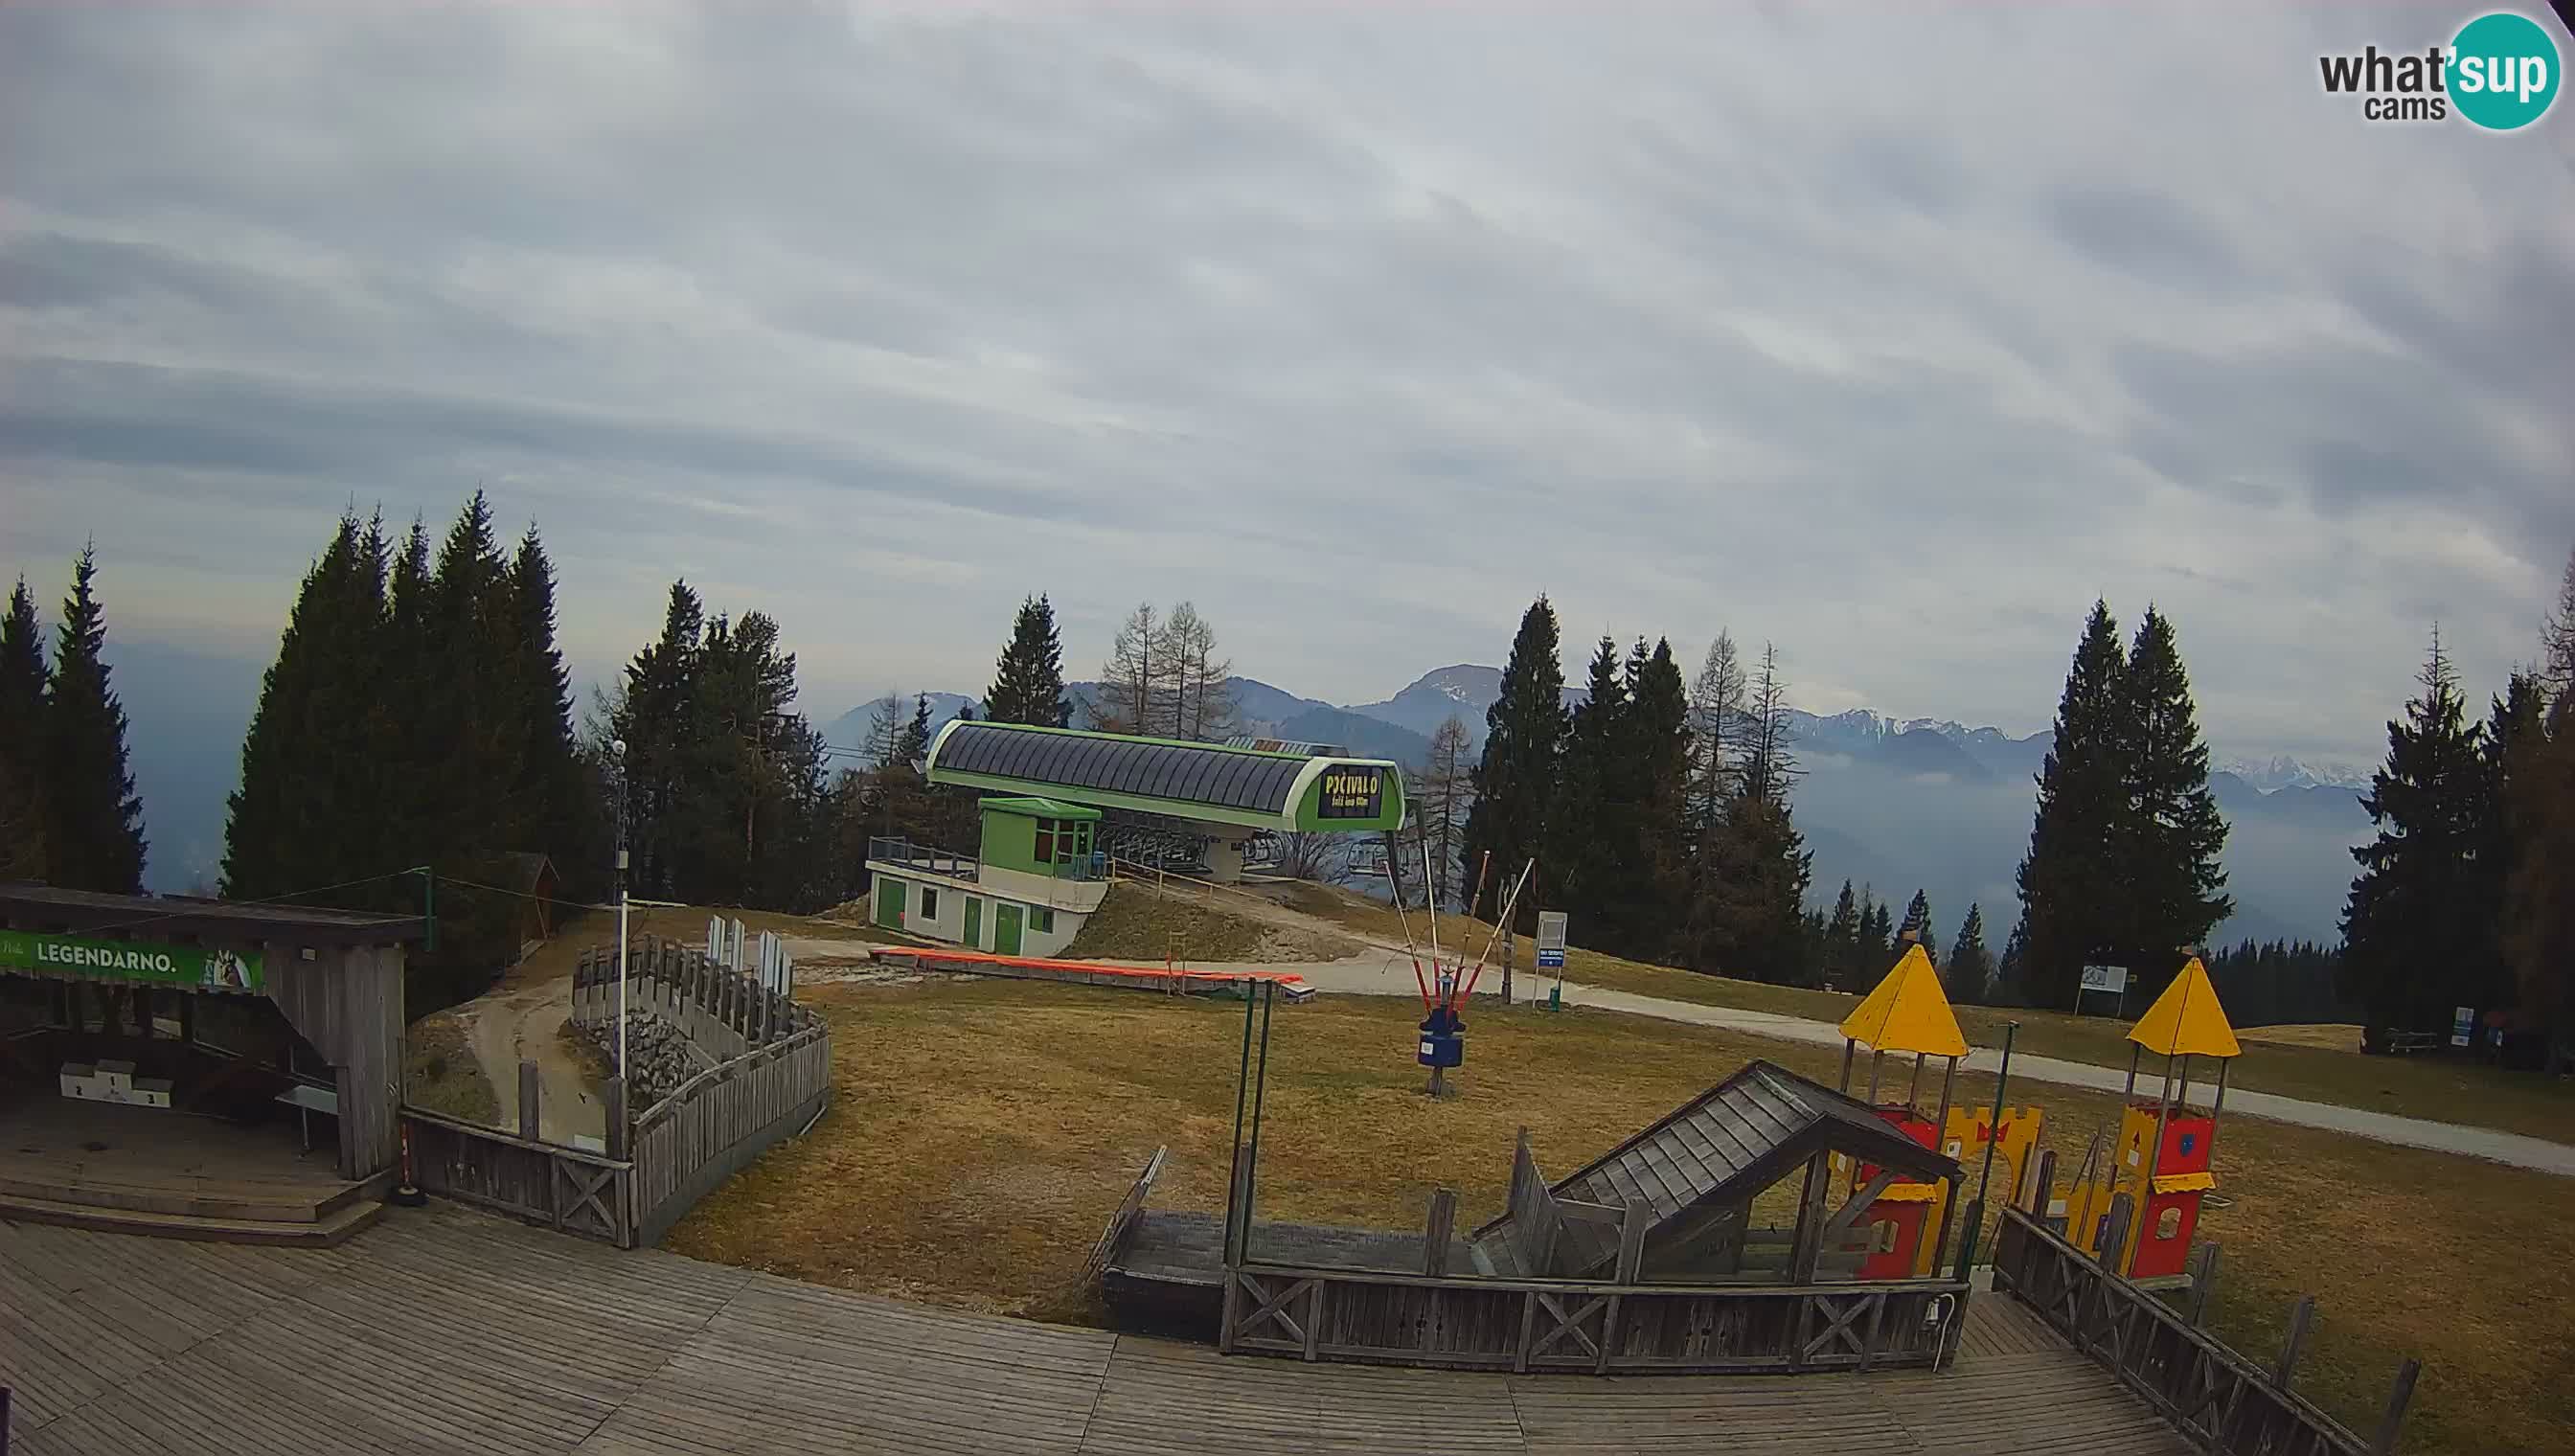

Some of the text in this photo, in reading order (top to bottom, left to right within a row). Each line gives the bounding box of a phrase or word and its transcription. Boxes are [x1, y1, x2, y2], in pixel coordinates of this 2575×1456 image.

[36, 942, 177, 974] LEGENDARNO.
[76, 1085, 83, 1096] 2
[148, 1094, 155, 1104] 3
